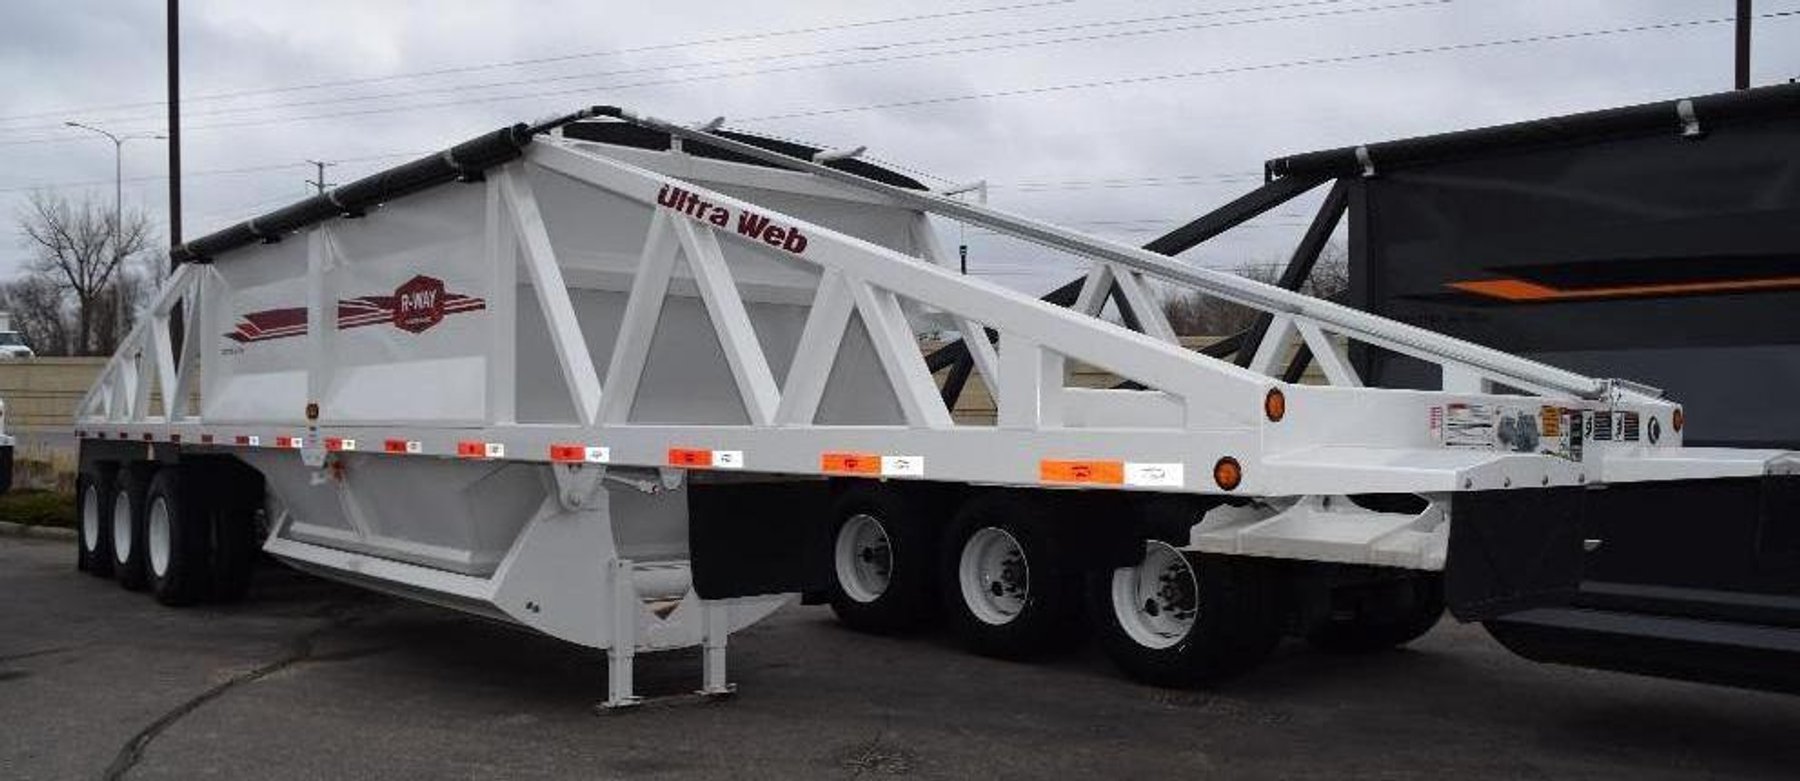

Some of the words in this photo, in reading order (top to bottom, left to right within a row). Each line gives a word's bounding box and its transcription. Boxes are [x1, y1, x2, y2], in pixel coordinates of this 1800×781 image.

[657, 183, 730, 228] Ultra
[737, 209, 808, 254] Web
[401, 289, 437, 313] R-WAY
